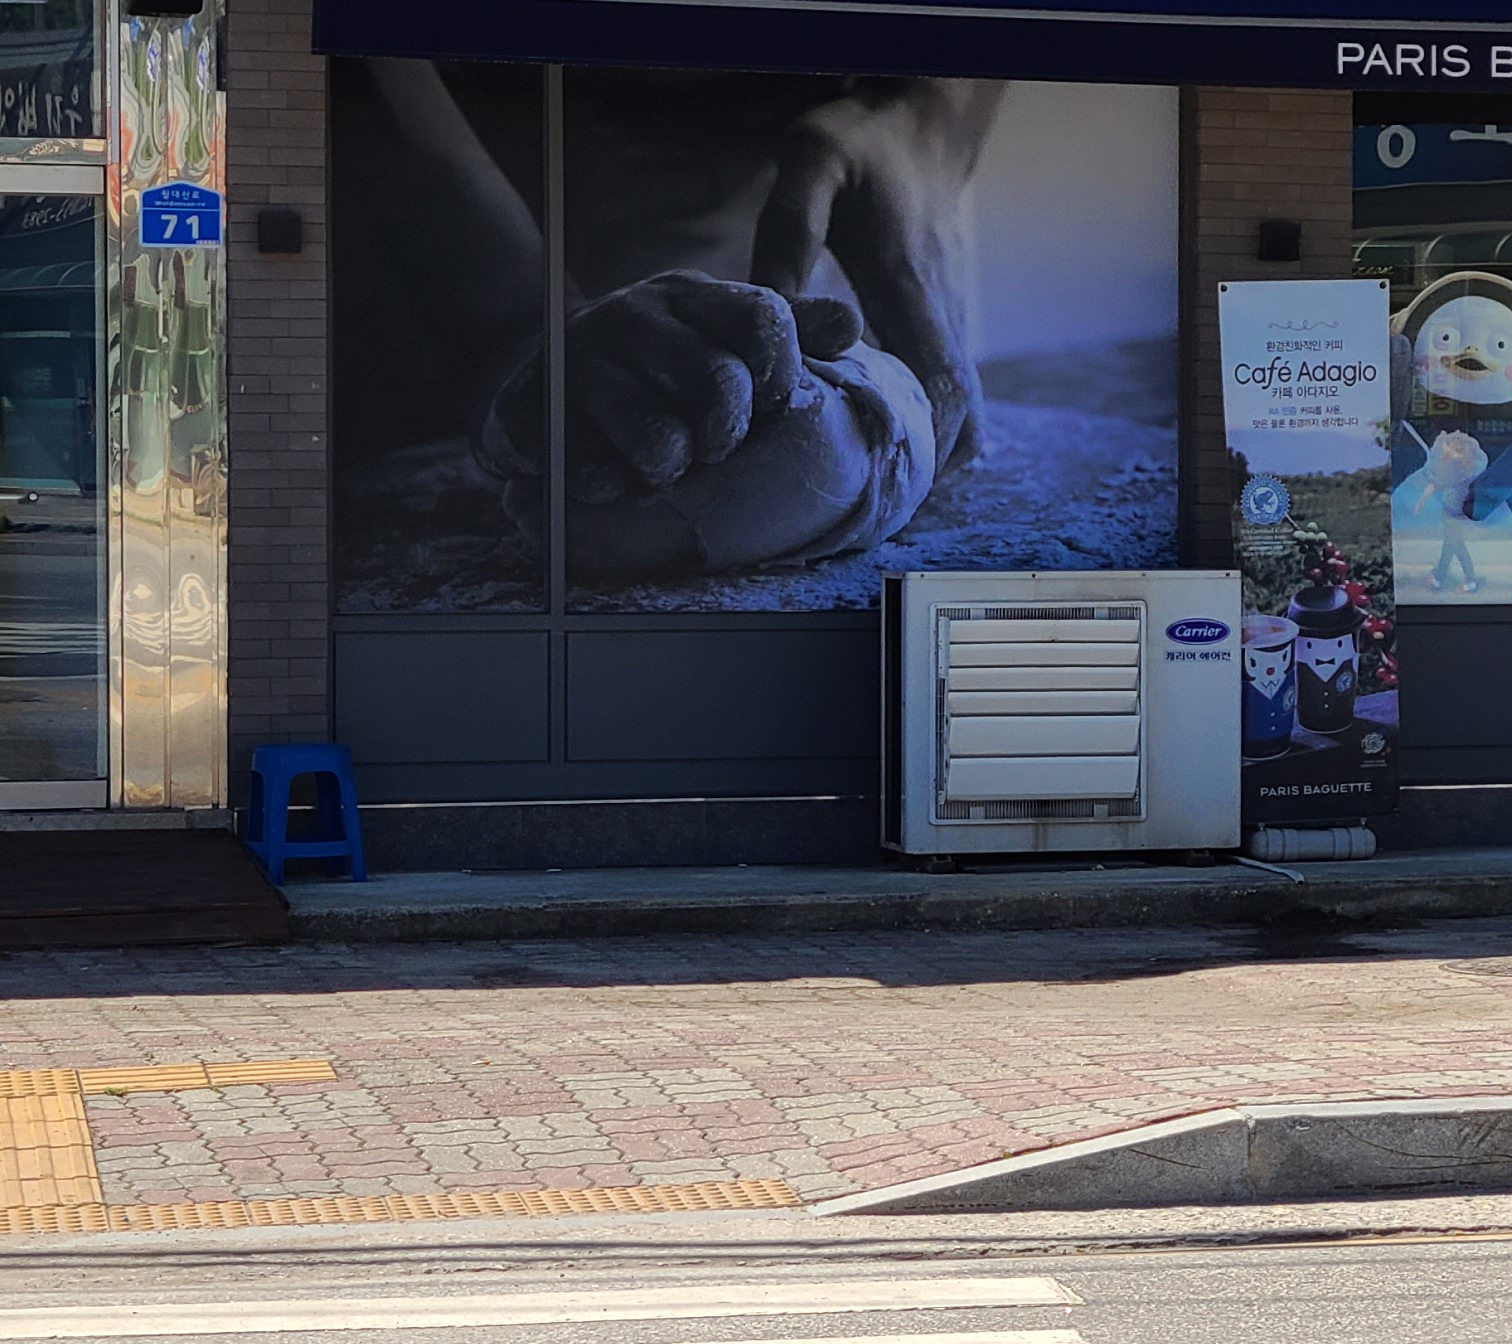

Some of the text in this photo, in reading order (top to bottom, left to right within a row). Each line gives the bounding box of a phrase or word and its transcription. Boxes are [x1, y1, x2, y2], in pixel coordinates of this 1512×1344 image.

[1337, 42, 1471, 77] PARIS
[161, 189, 200, 201] 월대산로
[160, 214, 200, 240] 71
[1266, 340, 1343, 353] 환경친화적인 커피
[1234, 356, 1377, 390] Café Adagio
[1272, 386, 1340, 399] 카페 아다지오
[1321, 417, 1358, 427] 생각합니다
[1174, 624, 1223, 639] Carrier
[1165, 651, 1231, 662] 캐리어 에어컨
[1259, 782, 1373, 797] PARIS BAGUETTE
